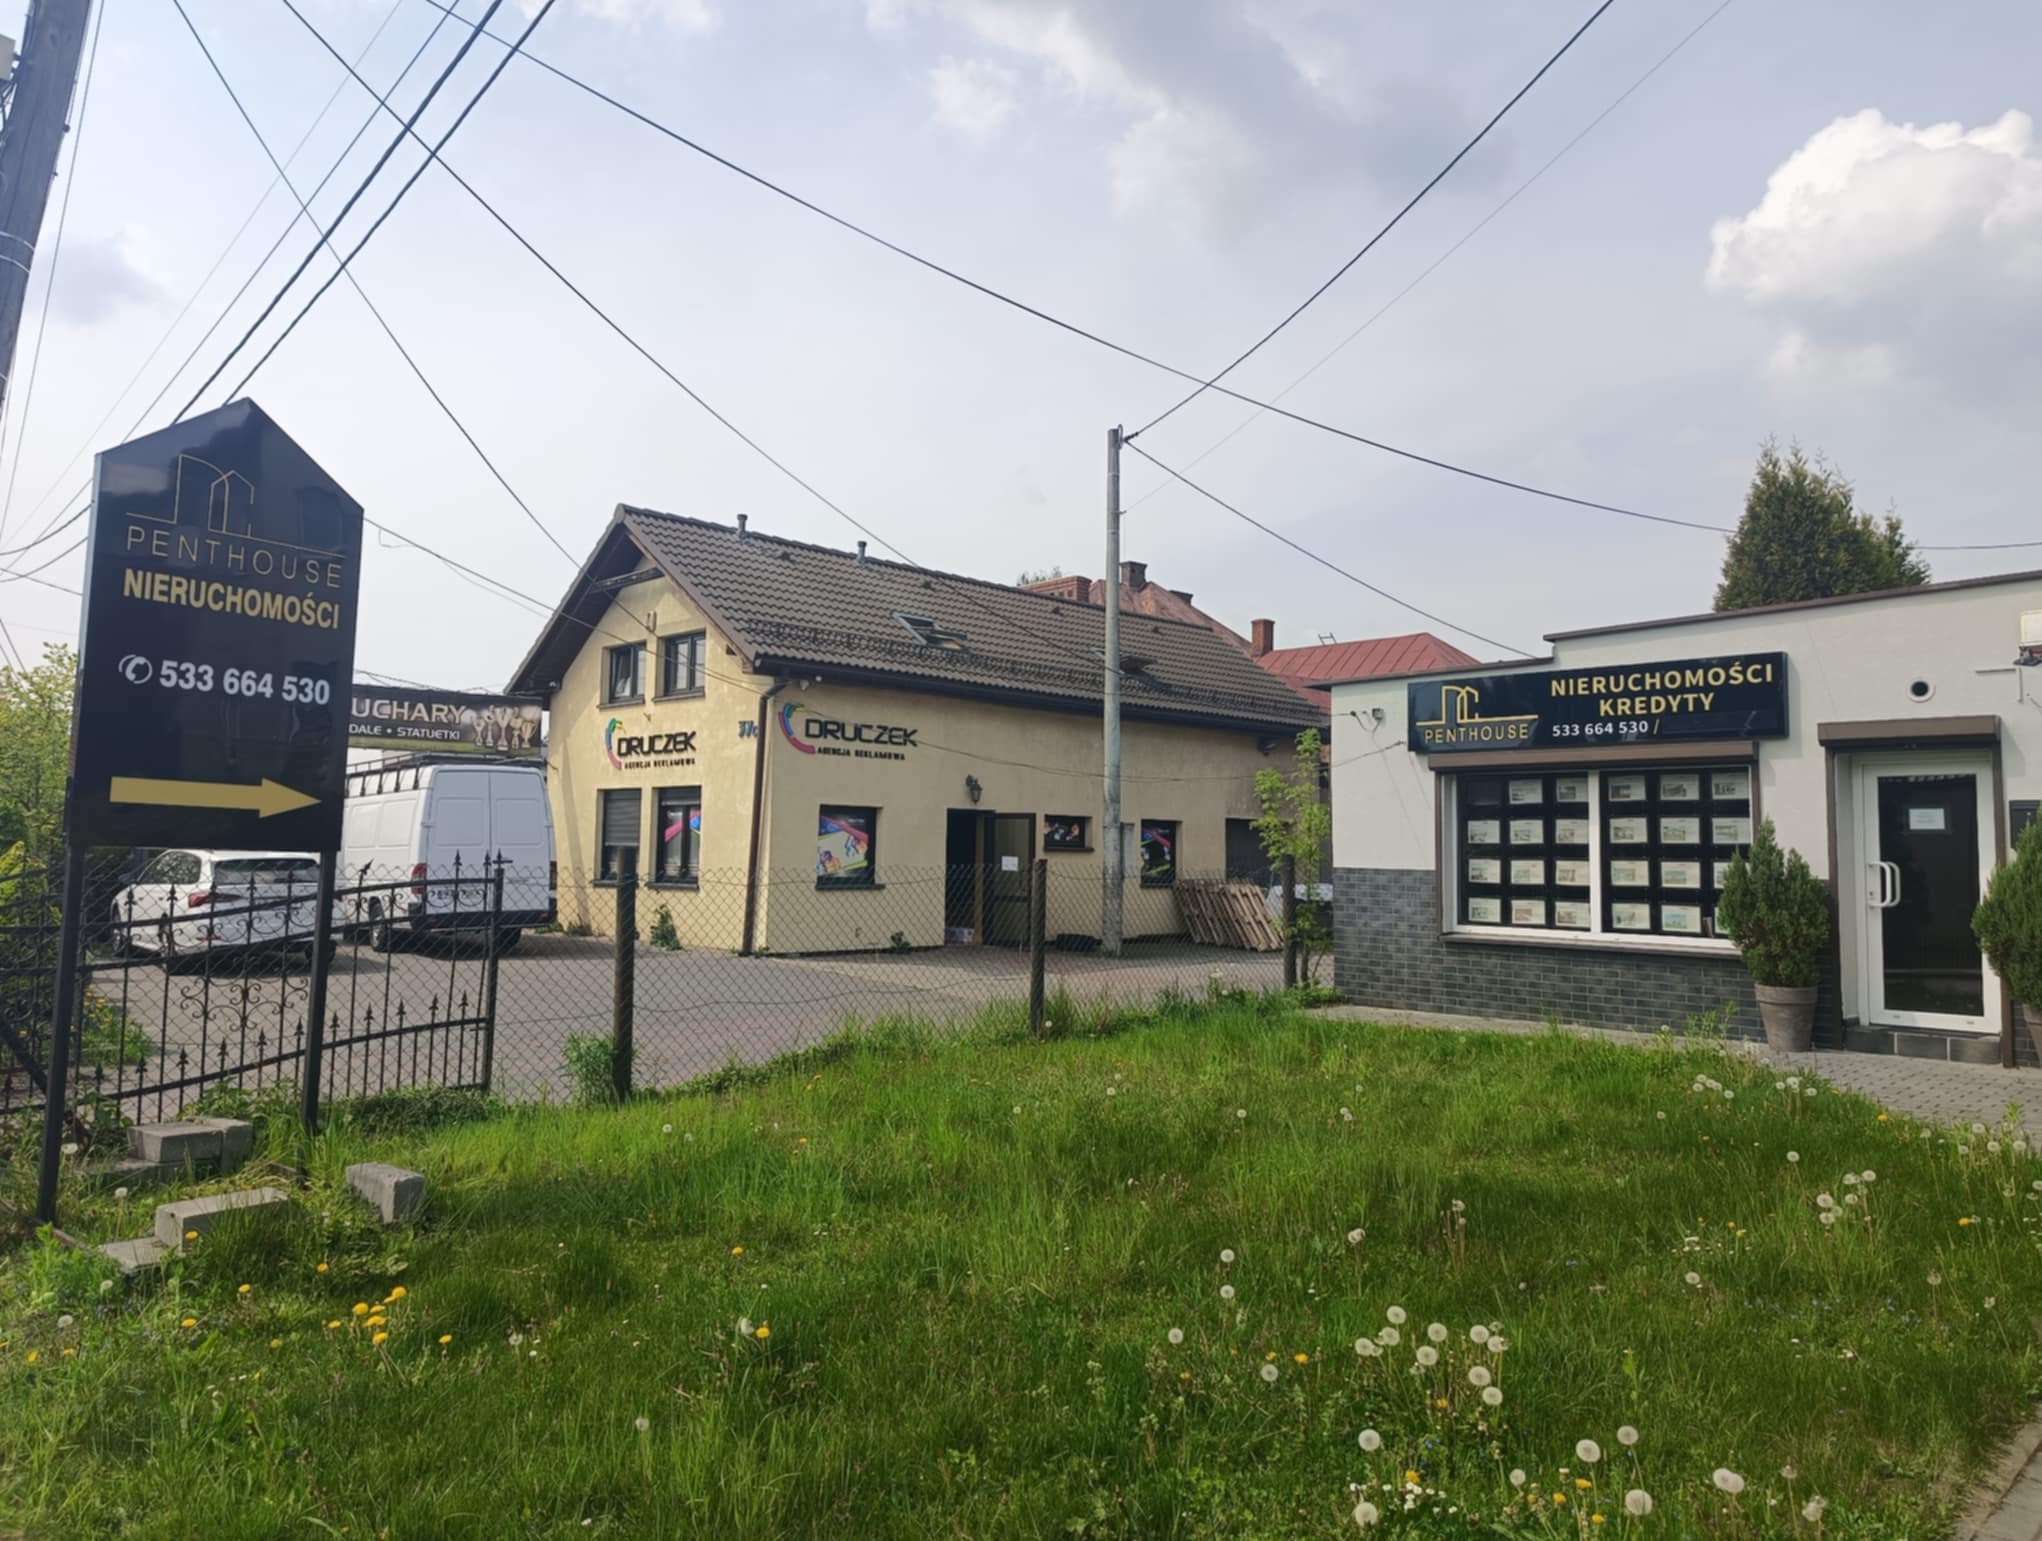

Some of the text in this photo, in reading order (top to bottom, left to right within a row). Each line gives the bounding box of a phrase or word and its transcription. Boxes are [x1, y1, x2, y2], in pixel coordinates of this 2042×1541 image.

[127, 525, 343, 588] PENTHOUSE
[123, 568, 340, 629] NIERUCHOMOŚCI
[159, 659, 330, 705] 533 664 530
[1551, 660, 1773, 697] NIERUCHOMOŚCI
[351, 697, 466, 724] UCHARY
[1600, 692, 1715, 717] KREDYTY
[348, 723, 460, 740] DALE STATUETKI
[805, 718, 918, 747] DRUCZEK
[1425, 723, 1529, 744] PENTHOUSE
[1552, 724, 1580, 737] 533
[1584, 722, 1613, 736] 664
[1618, 720, 1649, 734] 530
[617, 731, 697, 757] DRUCZEK
